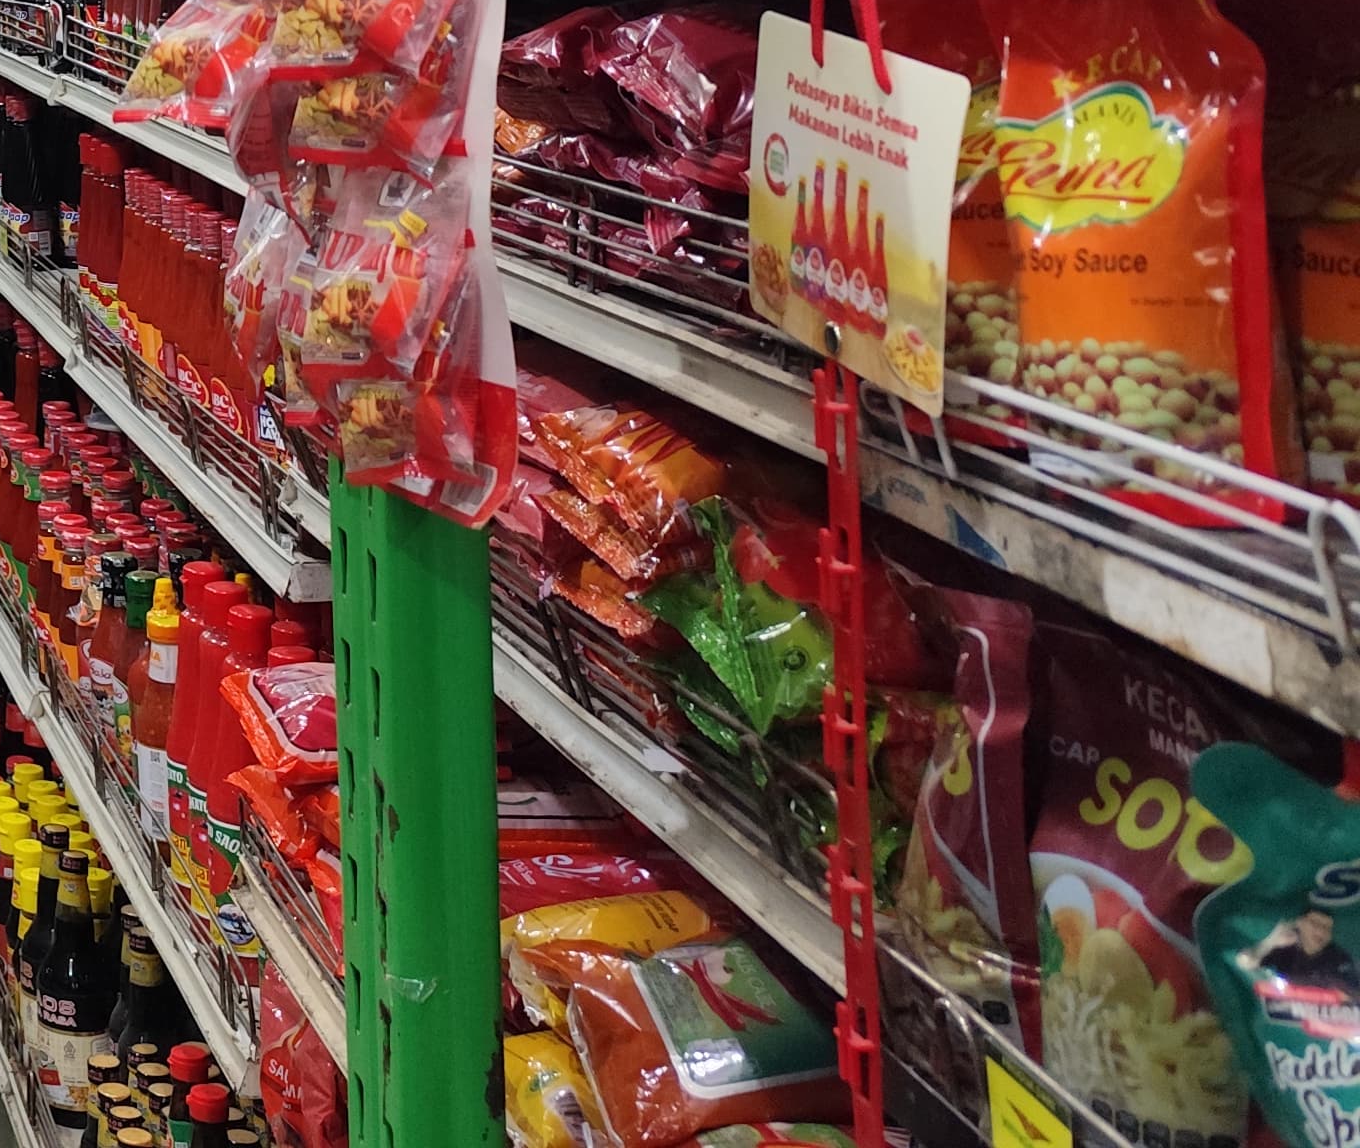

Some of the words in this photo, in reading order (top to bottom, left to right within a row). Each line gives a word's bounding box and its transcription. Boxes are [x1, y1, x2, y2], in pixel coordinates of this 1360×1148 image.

[786, 71, 841, 114] Pedasnya
[841, 92, 874, 125] Bikin
[875, 106, 919, 142] Semua
[787, 103, 840, 141] Makanan
[841, 124, 875, 157] Lebih
[877, 139, 910, 171] Enak
[951, 200, 1003, 222] auce
[1030, 249, 1066, 279] Soy
[1073, 246, 1149, 275] Sauce
[1123, 673, 1211, 743] KECA
[1048, 733, 1101, 764] CAP
[1148, 728, 1199, 768] MAN
